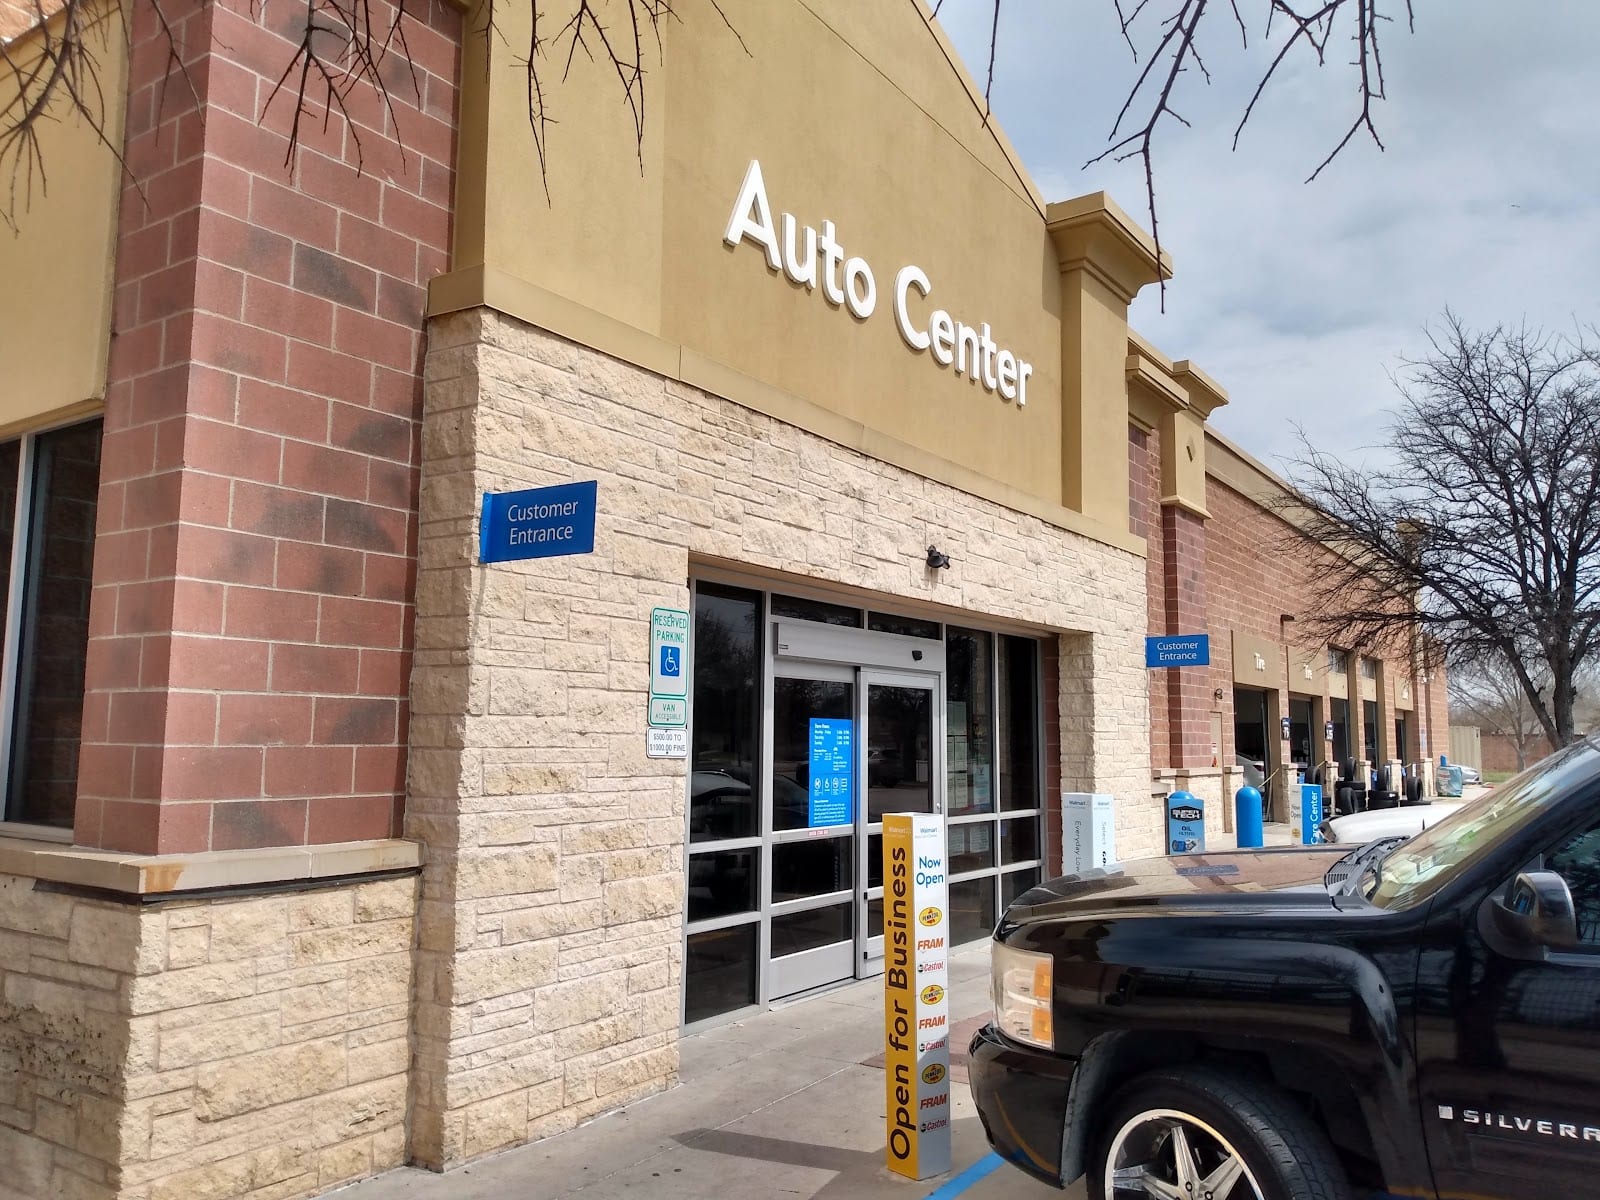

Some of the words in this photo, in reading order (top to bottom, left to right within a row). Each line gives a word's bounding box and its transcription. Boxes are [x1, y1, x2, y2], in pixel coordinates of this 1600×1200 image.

[723, 159, 877, 319] Auto
[893, 265, 1033, 407] Center
[507, 500, 578, 523] Customer
[509, 524, 573, 546] Entrance
[654, 614, 687, 629] RESERVED
[656, 629, 685, 643] PARKING
[1156, 640, 1199, 651] Customer
[1159, 651, 1197, 661] Entrance
[662, 703, 676, 712] VAN
[673, 744, 686, 752] FINE
[1309, 790, 1319, 822] Center
[1073, 820, 1082, 856] Everyday
[1310, 823, 1319, 845] Care
[918, 856, 941, 870] Now
[916, 872, 944, 888] Open
[887, 847, 908, 990] Business
[917, 937, 944, 951] FRAM
[923, 960, 944, 972] Castrol
[888, 999, 909, 1052] for
[918, 1015, 946, 1030] FRAM
[925, 1038, 946, 1051] Castrol
[919, 1093, 947, 1110] FRAM
[889, 1064, 917, 1161] Open
[925, 1119, 947, 1131] Castrol
[1463, 1109, 1600, 1142] SILVERA
